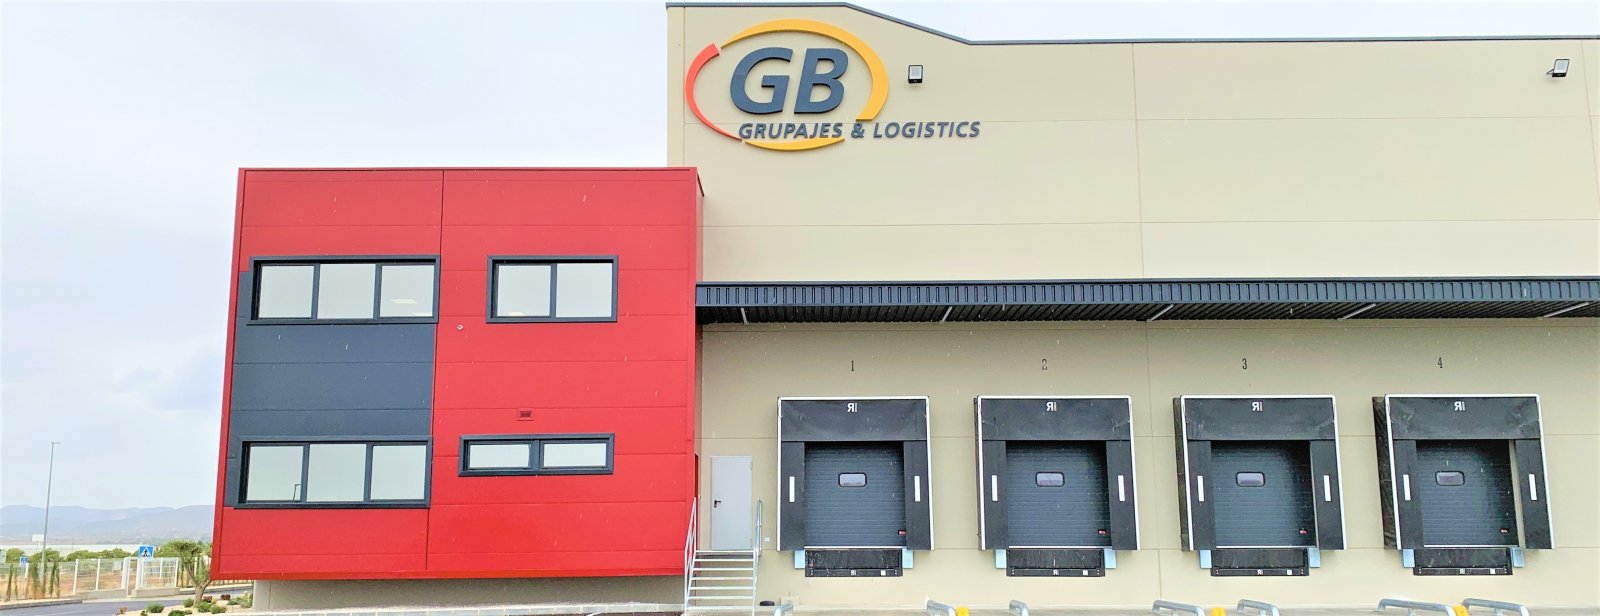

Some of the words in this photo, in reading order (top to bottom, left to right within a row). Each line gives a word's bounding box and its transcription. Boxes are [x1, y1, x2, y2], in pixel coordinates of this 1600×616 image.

[729, 46, 849, 115] GB
[738, 122, 843, 140] GRUPAJES
[850, 121, 865, 138] &
[873, 121, 981, 139] LOGISTICS
[850, 360, 855, 372] 1
[1041, 358, 1048, 371] 2
[1242, 358, 1248, 370] 3
[1437, 356, 1443, 369] 4
